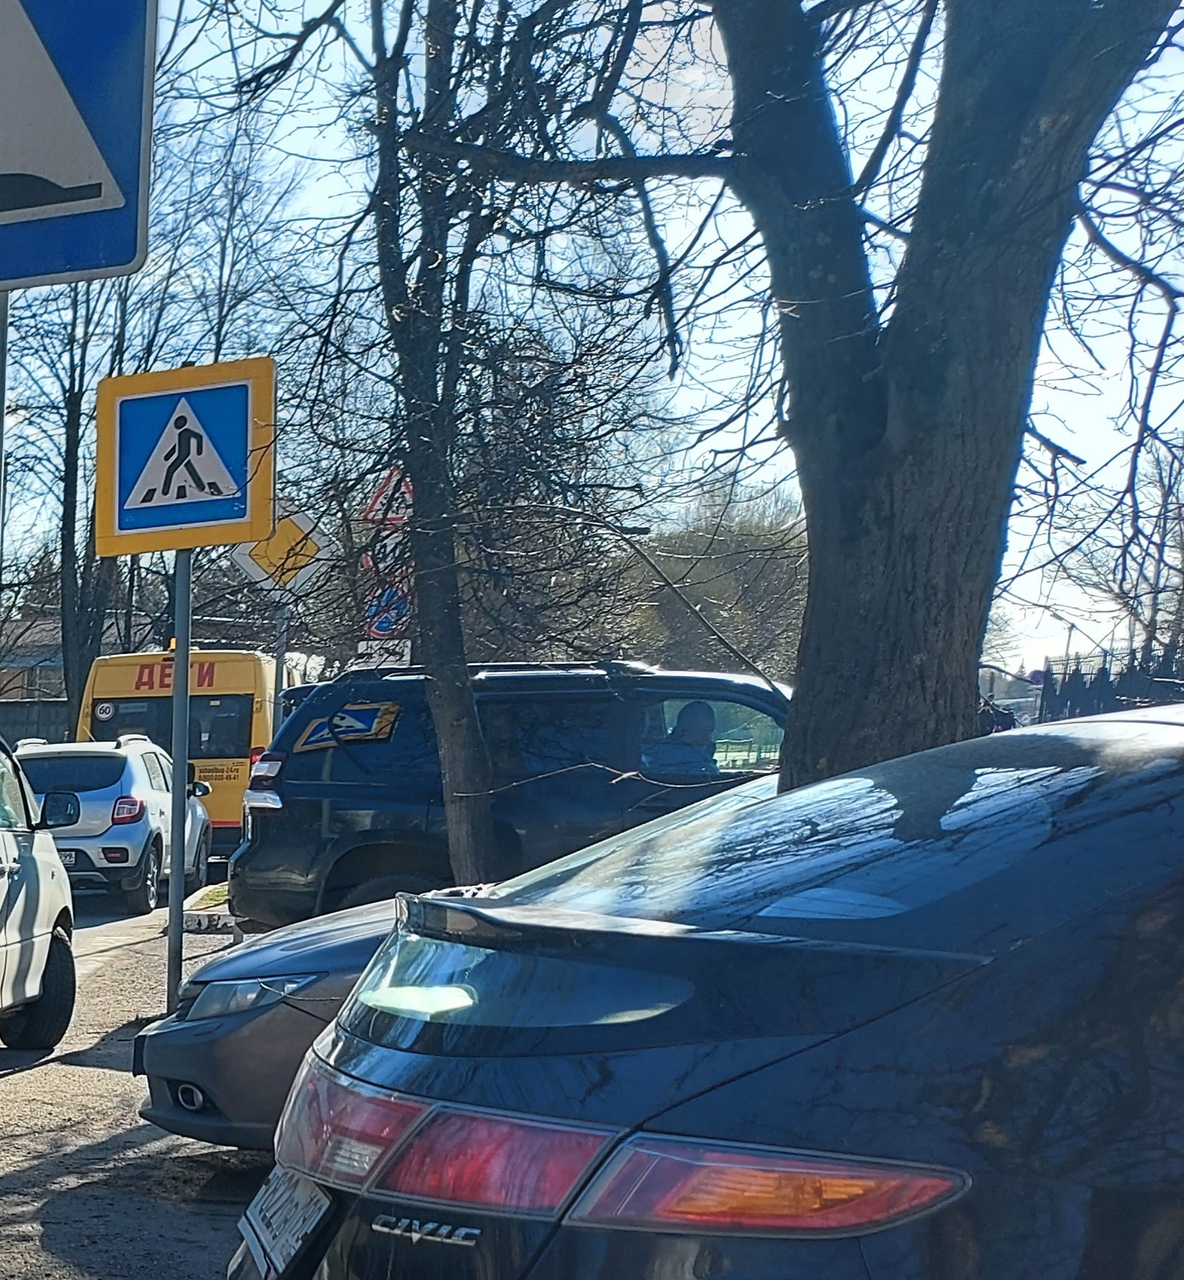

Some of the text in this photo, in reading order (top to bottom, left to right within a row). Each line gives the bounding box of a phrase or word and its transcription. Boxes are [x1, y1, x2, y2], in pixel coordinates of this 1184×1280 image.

[135, 662, 215, 690] ДЕИ
[99, 704, 111, 715] 60
[372, 1214, 481, 1246] CIVIC
